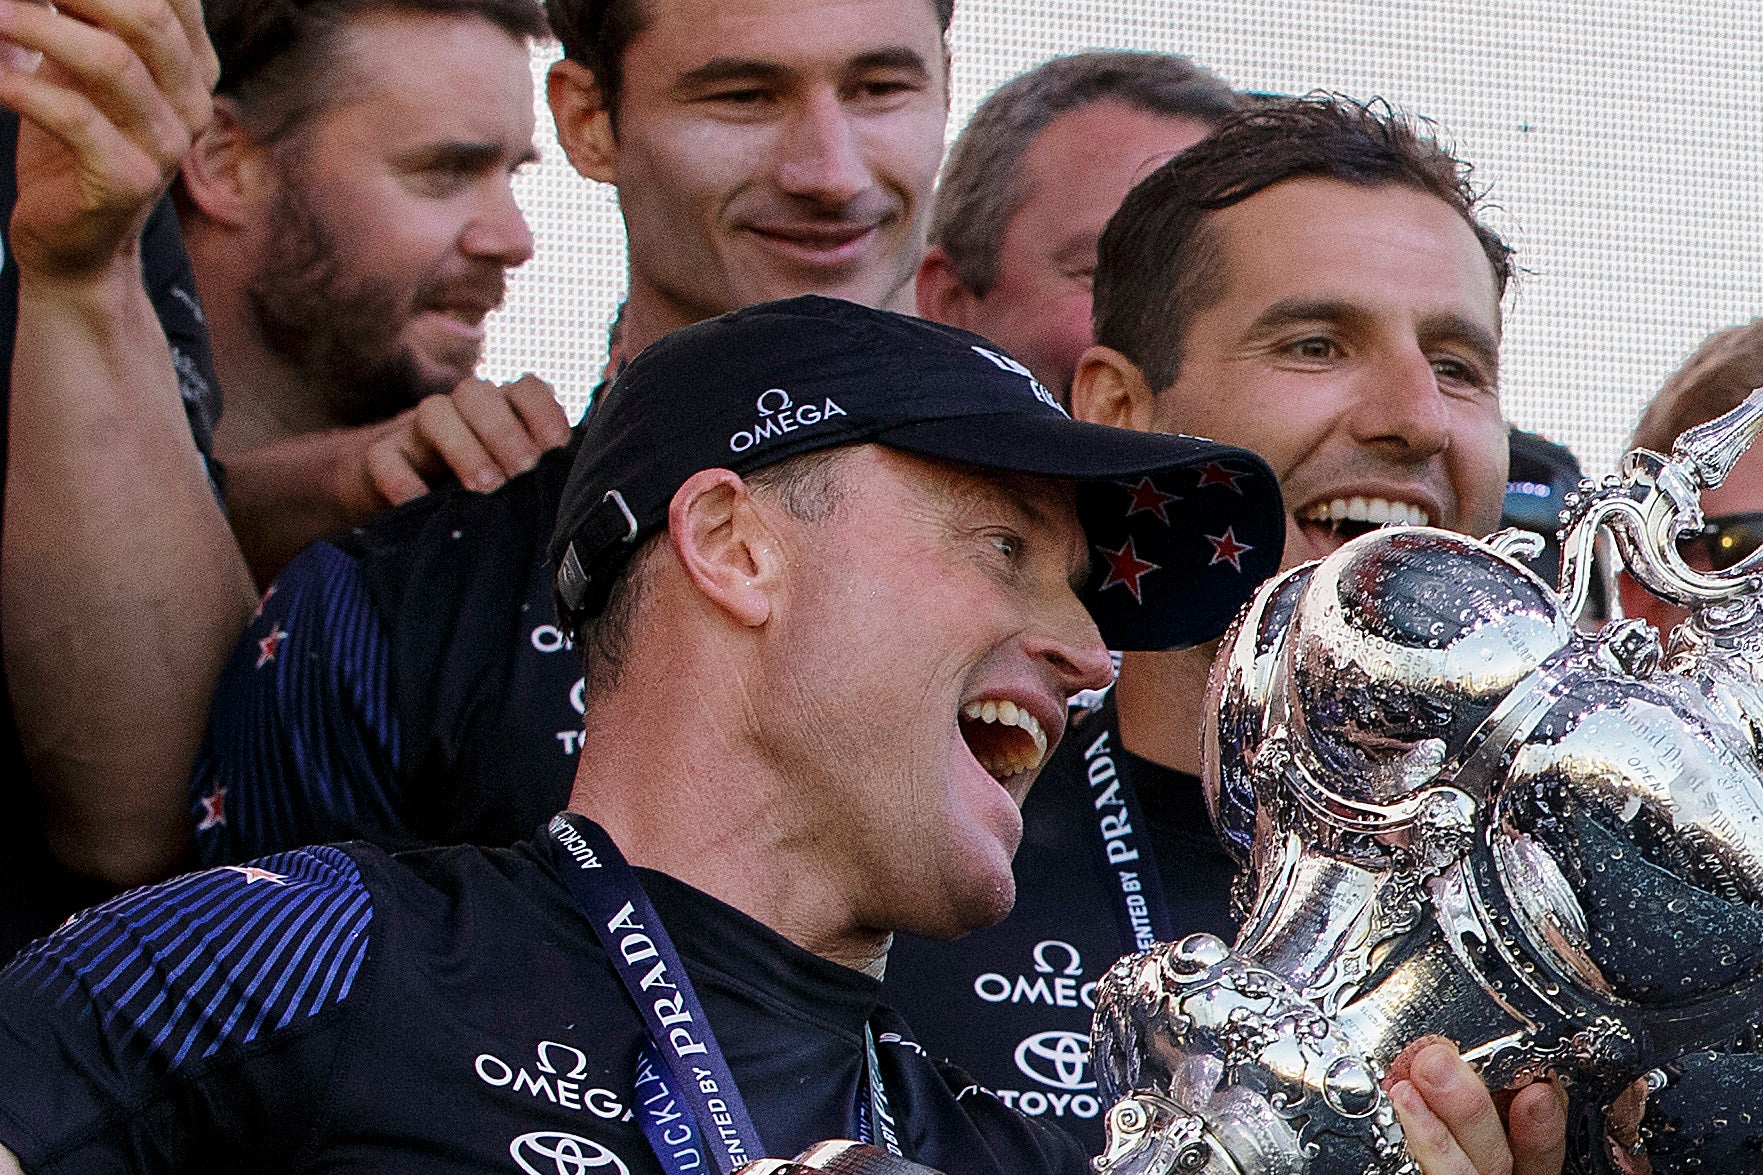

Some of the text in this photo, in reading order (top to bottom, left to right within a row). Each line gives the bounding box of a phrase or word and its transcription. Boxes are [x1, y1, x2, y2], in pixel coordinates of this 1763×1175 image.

[729, 397, 847, 453] OMEGA
[1084, 731, 1155, 956] ENTED BY PRADA
[607, 900, 748, 1171] ENTED BY PRADA
